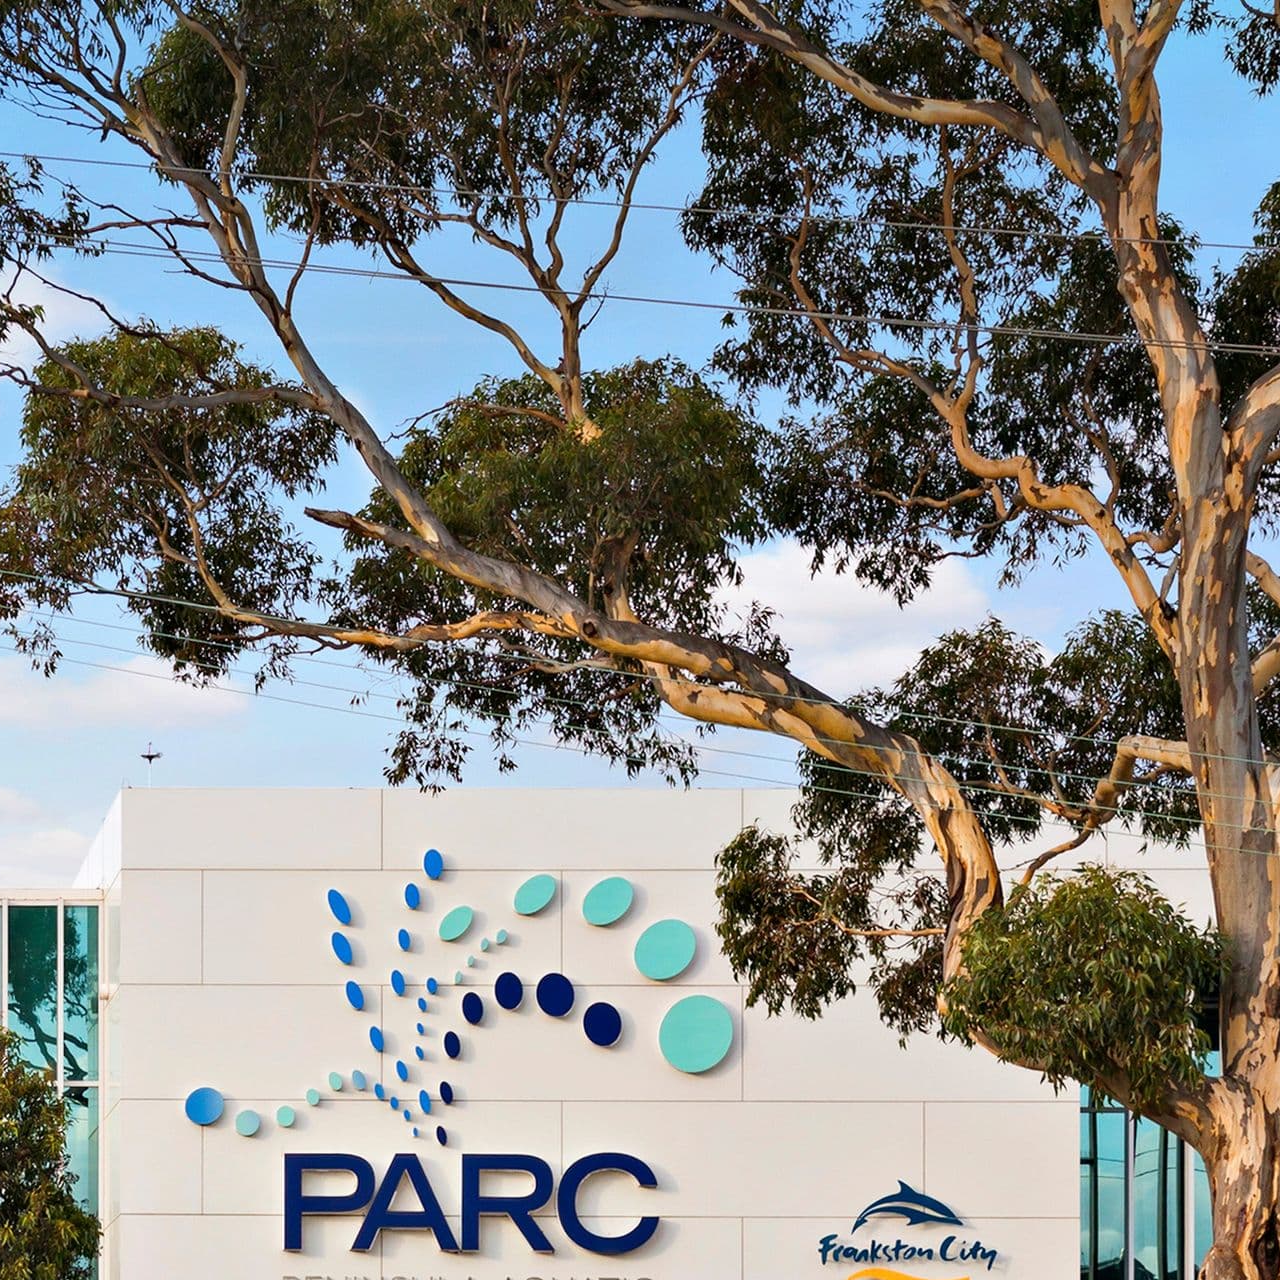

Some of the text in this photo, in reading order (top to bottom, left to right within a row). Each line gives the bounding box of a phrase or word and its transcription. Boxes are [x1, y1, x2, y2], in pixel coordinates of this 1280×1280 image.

[283, 1151, 660, 1255] PARC
[818, 1233, 998, 1271] Frankston City
